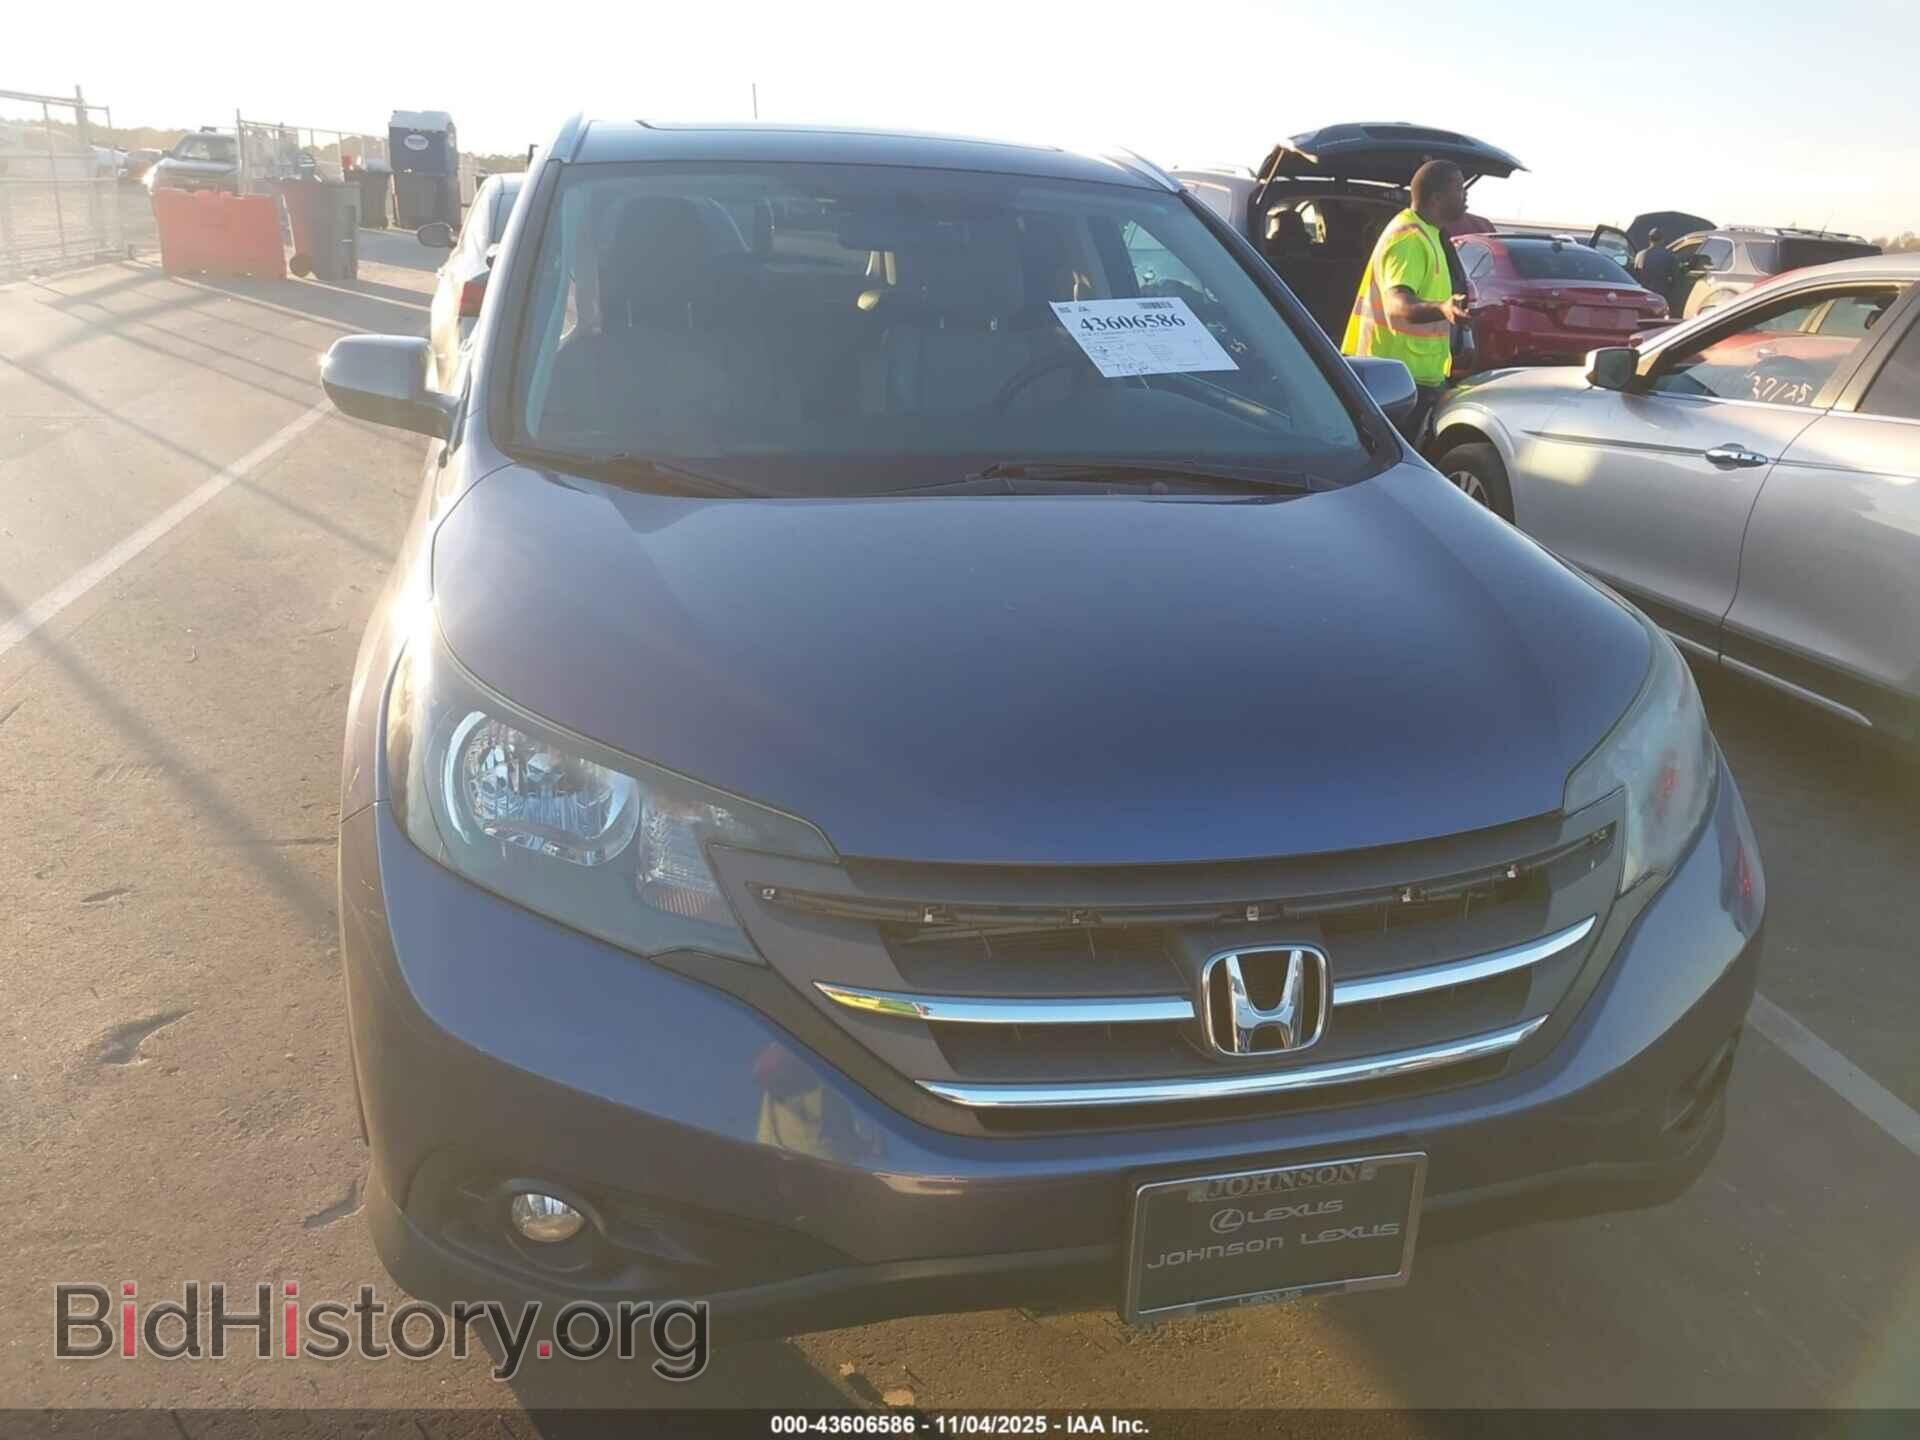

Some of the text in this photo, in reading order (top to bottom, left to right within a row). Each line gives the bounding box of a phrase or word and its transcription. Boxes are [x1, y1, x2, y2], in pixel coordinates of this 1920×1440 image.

[1080, 313, 1186, 332] 43606586
[1206, 1163, 1362, 1198] JOHNSON
[1248, 1199, 1344, 1223] LEXUS
[1147, 1222, 1400, 1269] JOHNSON LEXUS
